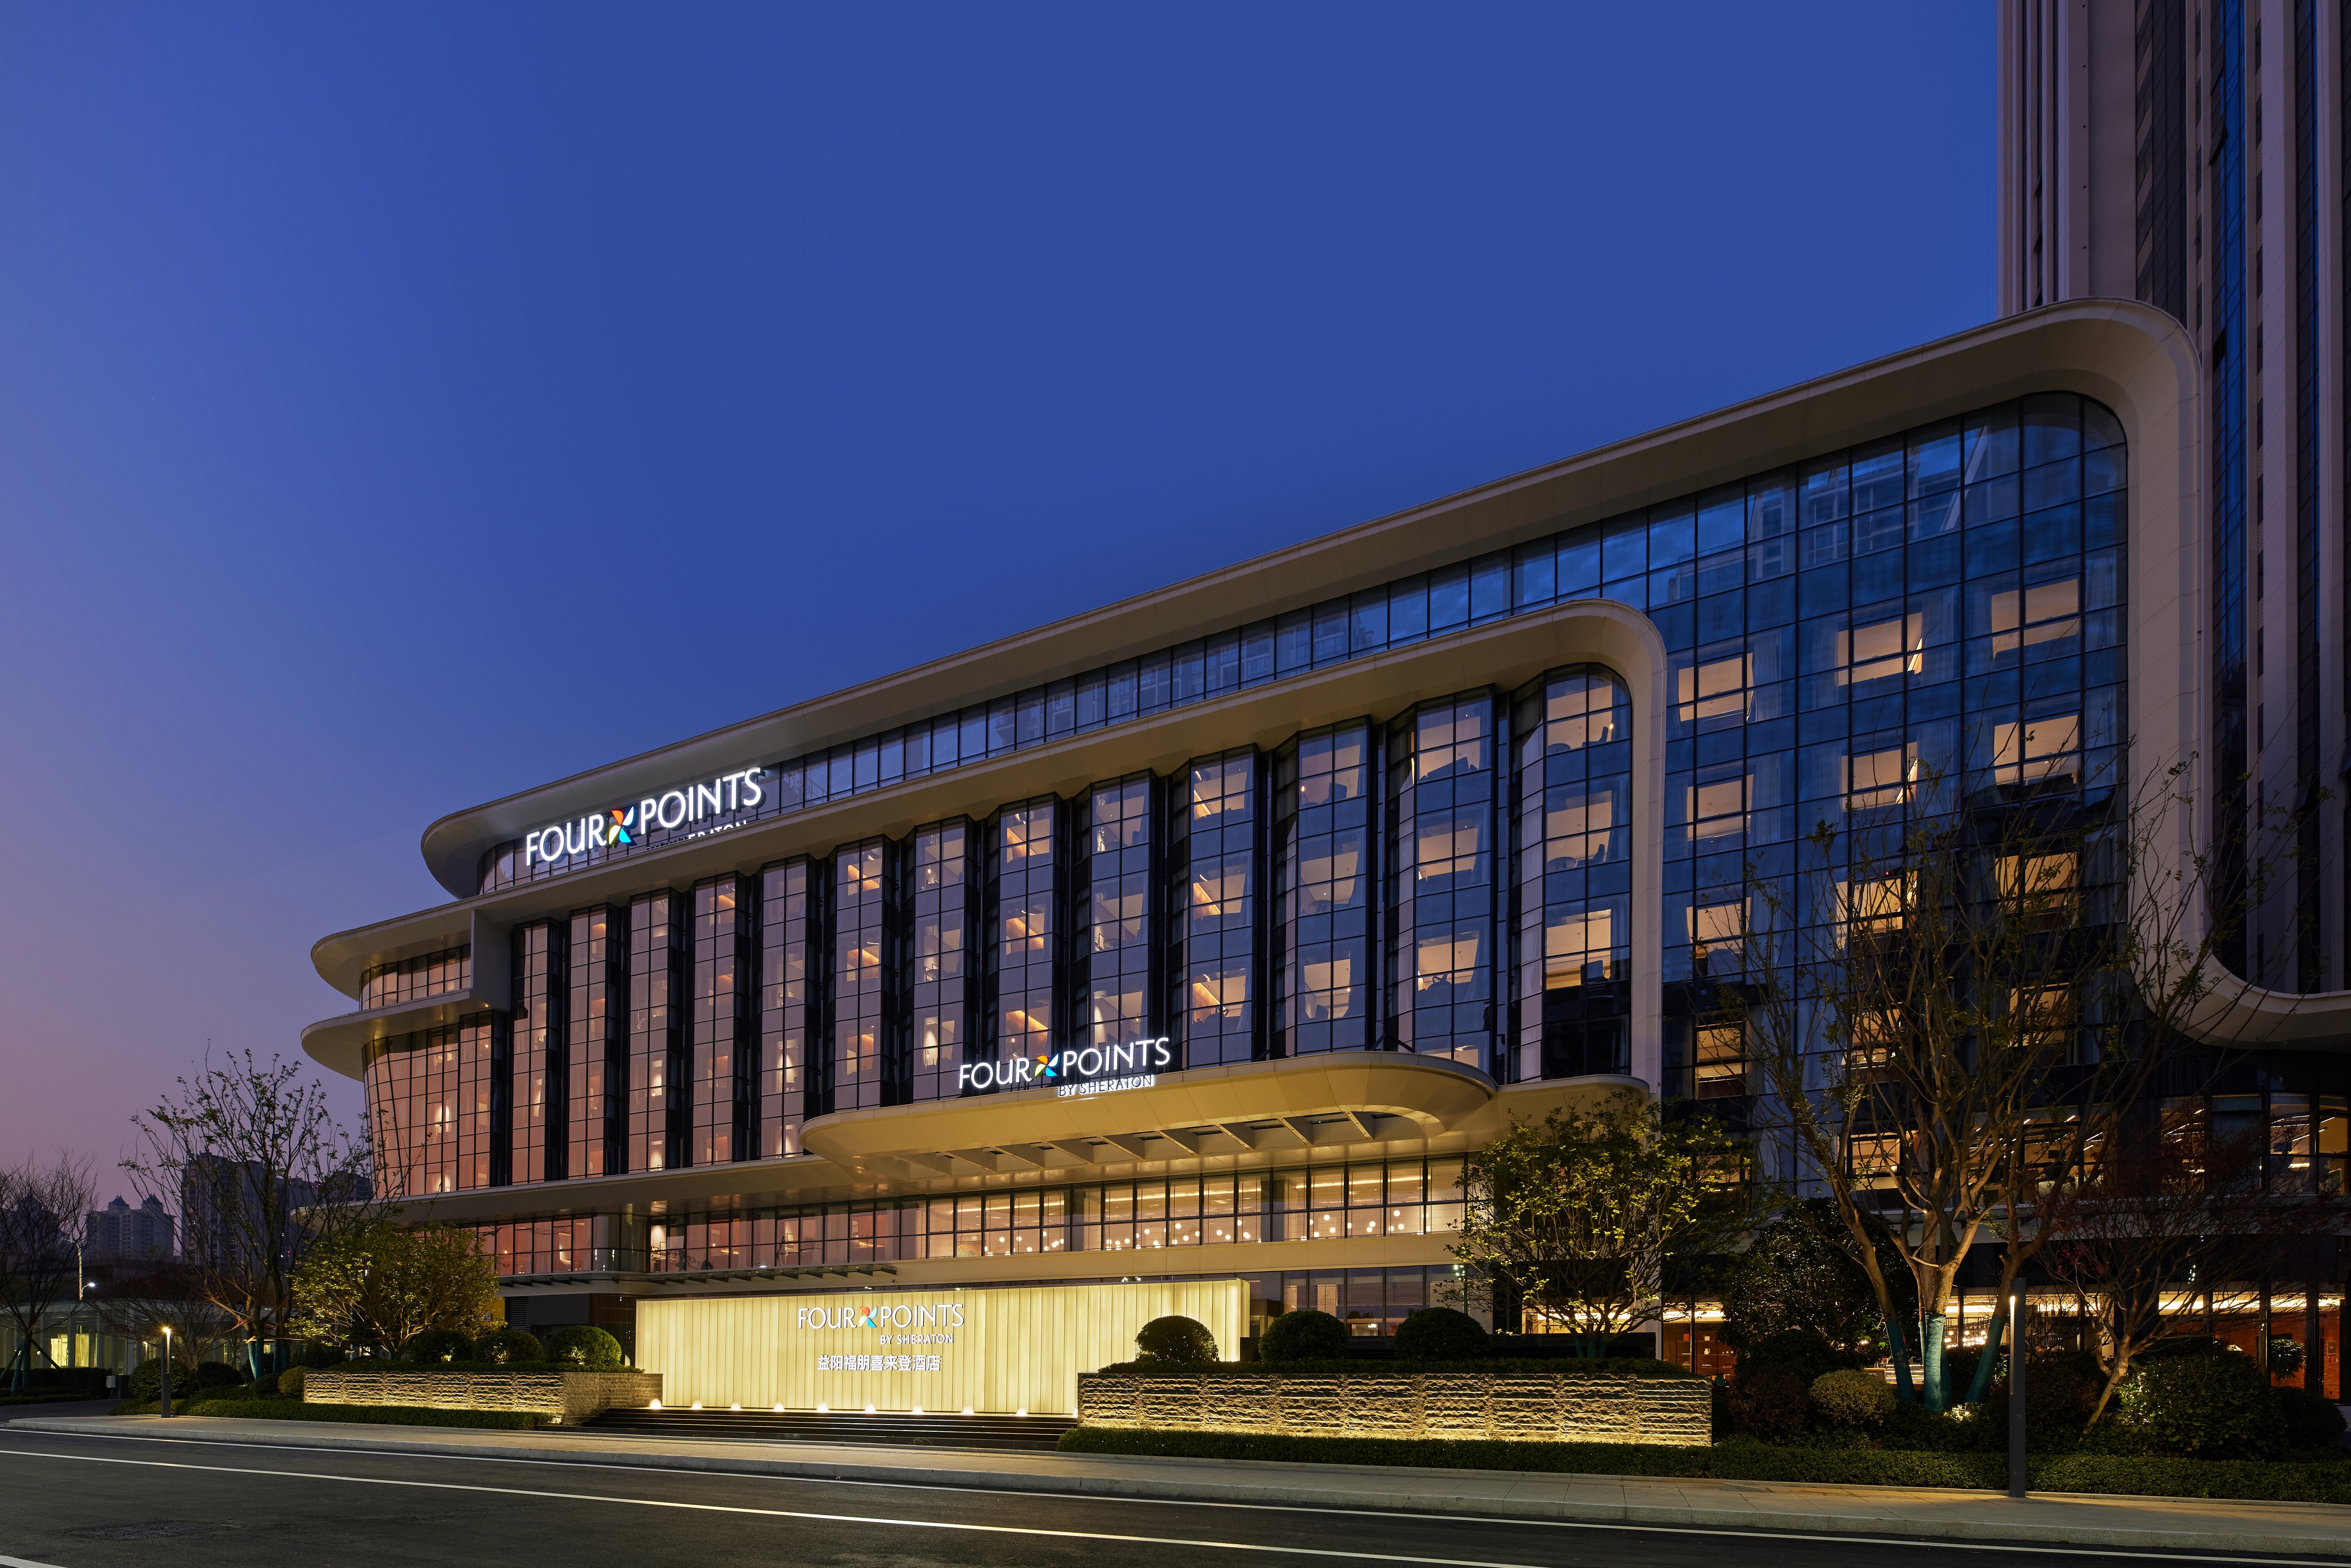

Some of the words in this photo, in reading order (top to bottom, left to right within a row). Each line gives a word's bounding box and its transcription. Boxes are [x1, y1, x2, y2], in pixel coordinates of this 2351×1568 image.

[526, 813, 607, 867] FOUR
[640, 767, 761, 835] POINTS
[959, 1057, 1032, 1089] FOUR
[1063, 1037, 1170, 1077] POINTS
[1058, 1084, 1077, 1097] BY
[1080, 1075, 1154, 1094] SHERATON
[798, 1308, 857, 1329] FOUR
[881, 1304, 964, 1328] POINTS
[880, 1335, 893, 1344] BY
[897, 1334, 953, 1344] SHERATON
[817, 1354, 941, 1371] 益阳福朋喜来登酒店
